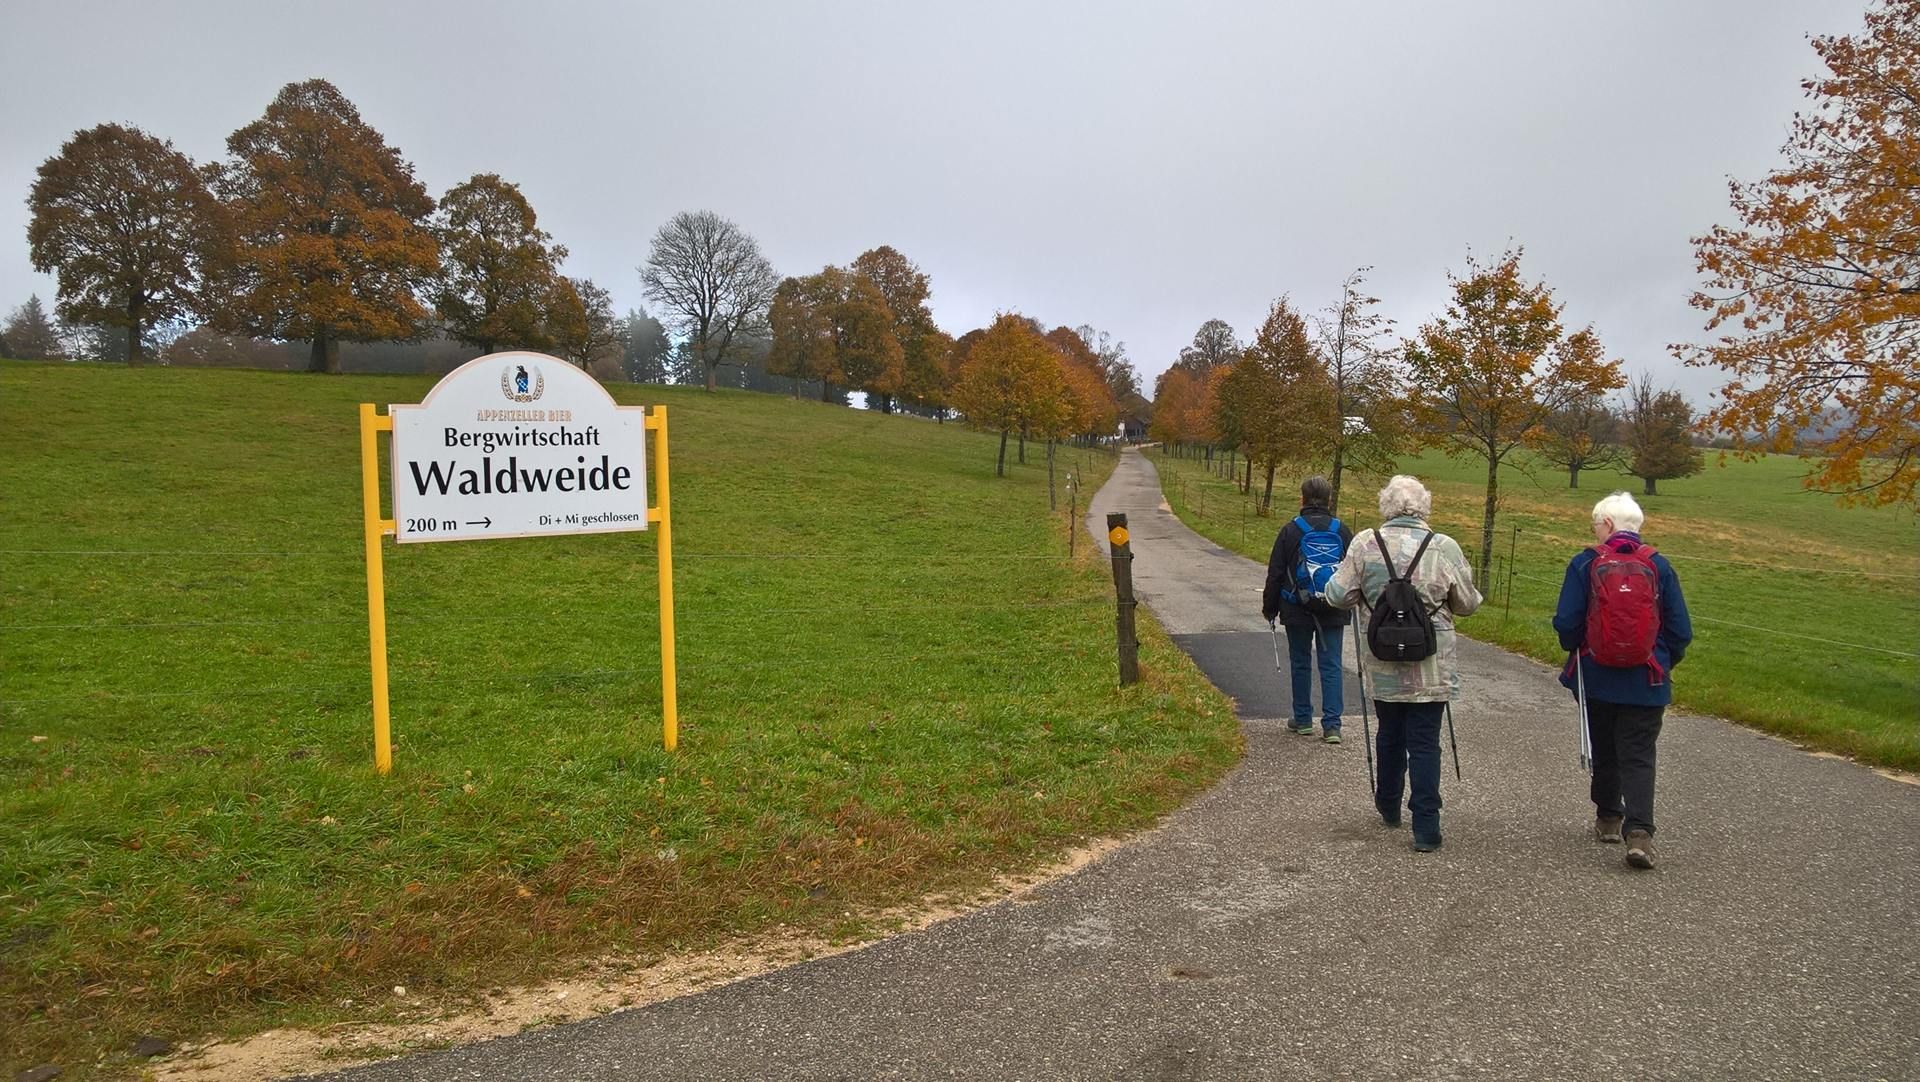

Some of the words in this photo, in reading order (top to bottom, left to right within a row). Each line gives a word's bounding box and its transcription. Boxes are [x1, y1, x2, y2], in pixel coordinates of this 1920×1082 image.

[477, 409, 546, 422] APPENZELLER
[548, 409, 573, 422] BIER
[443, 425, 601, 454] Bergwirtschaft
[408, 455, 631, 496] Waldweide
[406, 517, 437, 533] 200
[442, 520, 457, 531] m
[539, 514, 552, 526] Di
[554, 516, 562, 525] +
[565, 513, 579, 524] Mi
[581, 511, 640, 527] geschlossen
